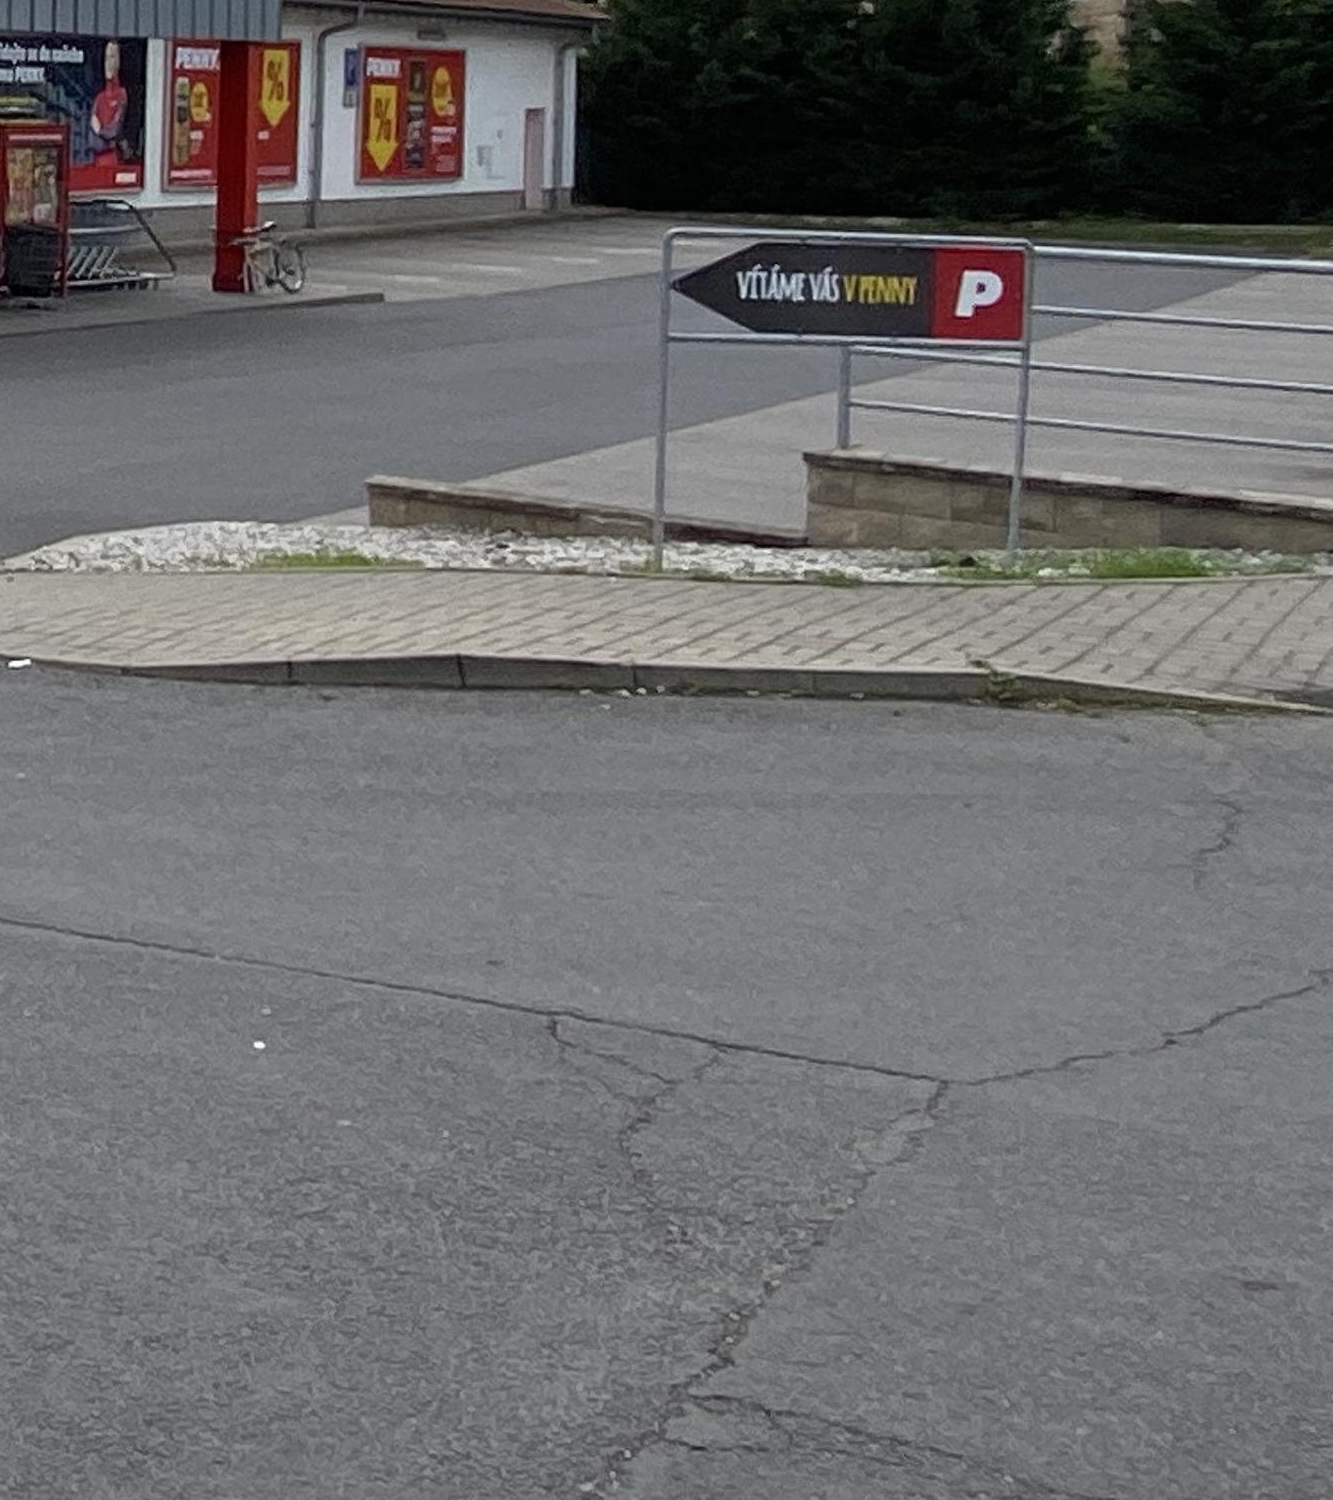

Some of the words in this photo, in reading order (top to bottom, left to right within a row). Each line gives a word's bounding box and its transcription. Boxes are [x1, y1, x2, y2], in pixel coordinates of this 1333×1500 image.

[736, 263, 806, 302] VÍTÁME
[808, 265, 840, 302] VÁS
[843, 274, 858, 303] V
[858, 274, 918, 306] PENNY
[954, 270, 1004, 318] P
